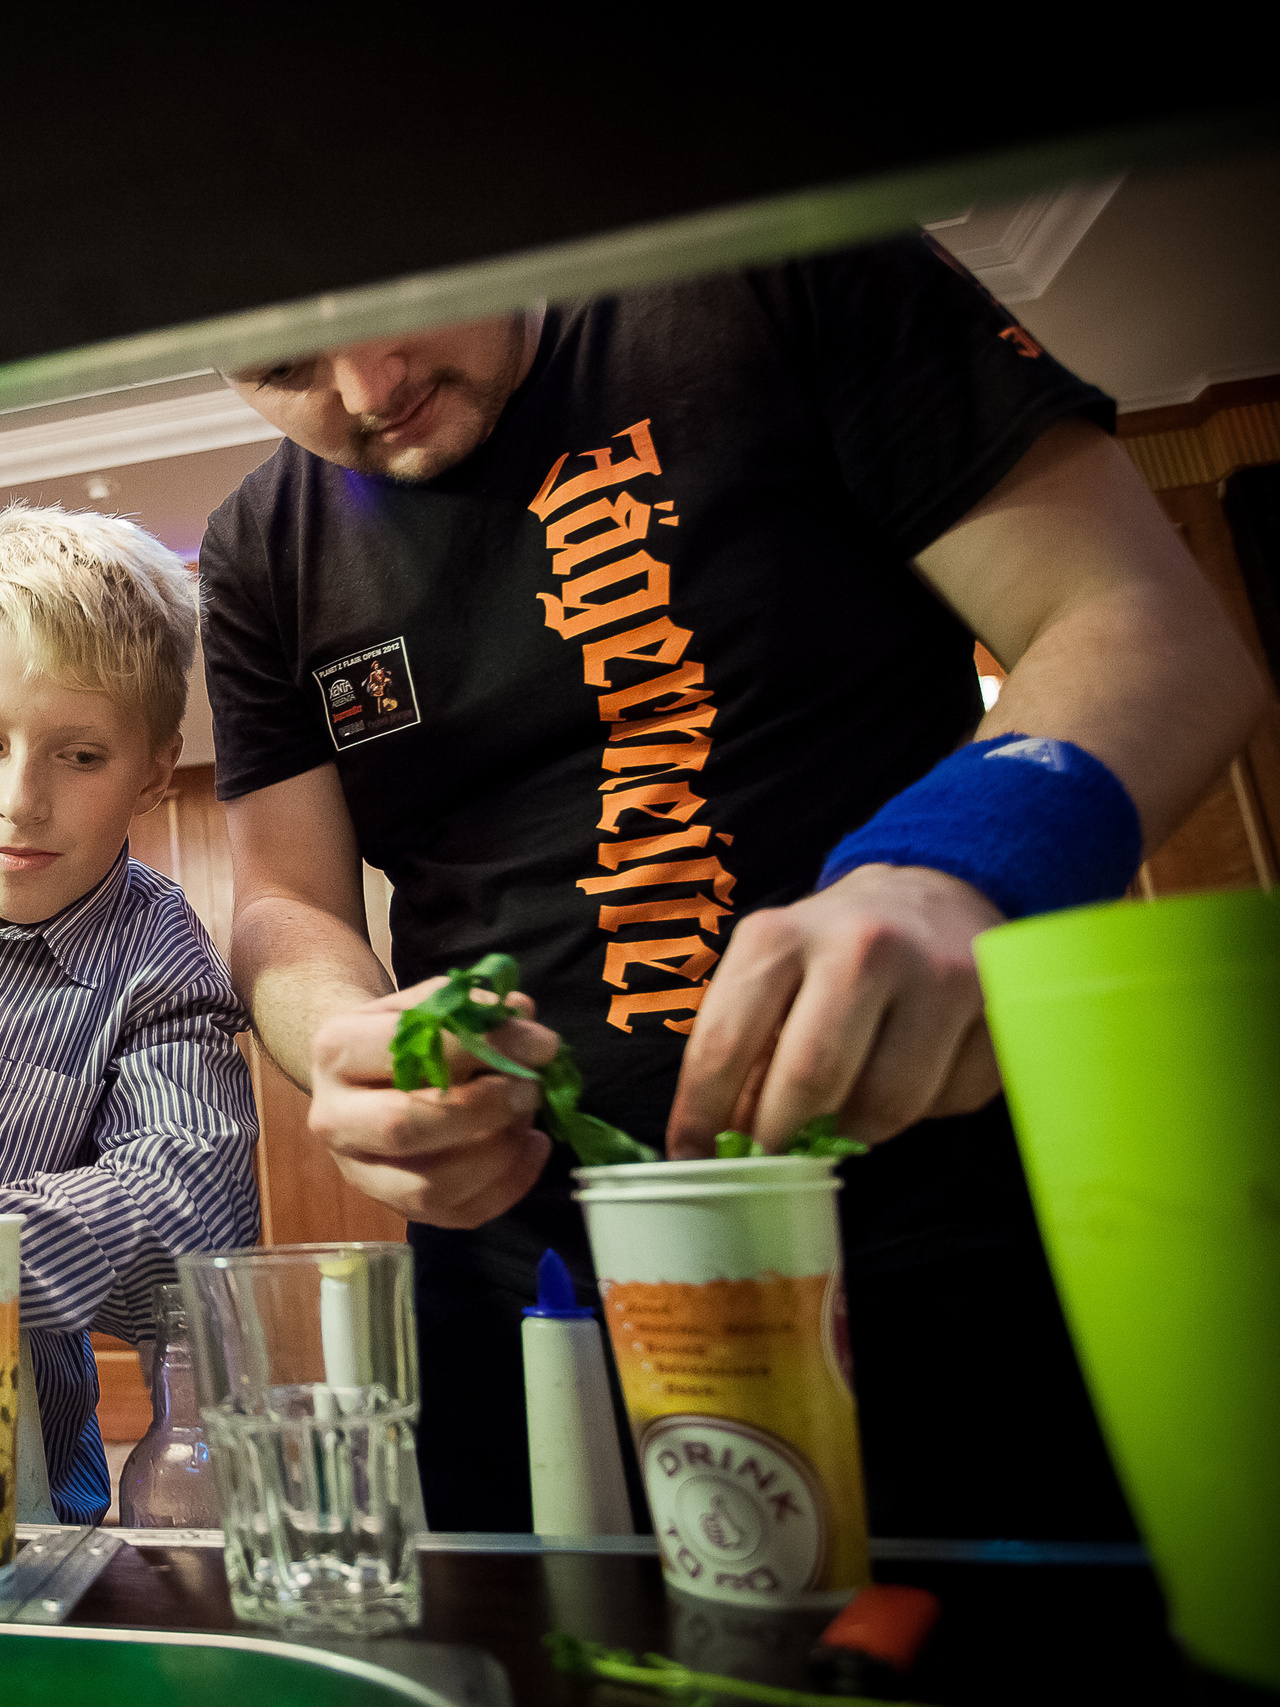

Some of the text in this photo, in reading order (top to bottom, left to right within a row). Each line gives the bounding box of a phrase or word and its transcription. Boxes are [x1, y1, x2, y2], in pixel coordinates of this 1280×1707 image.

[363, 649, 382, 661] OPEN
[382, 642, 401, 654] 2012
[328, 679, 354, 700] XENTA
[657, 1441, 803, 1523] DRINK
